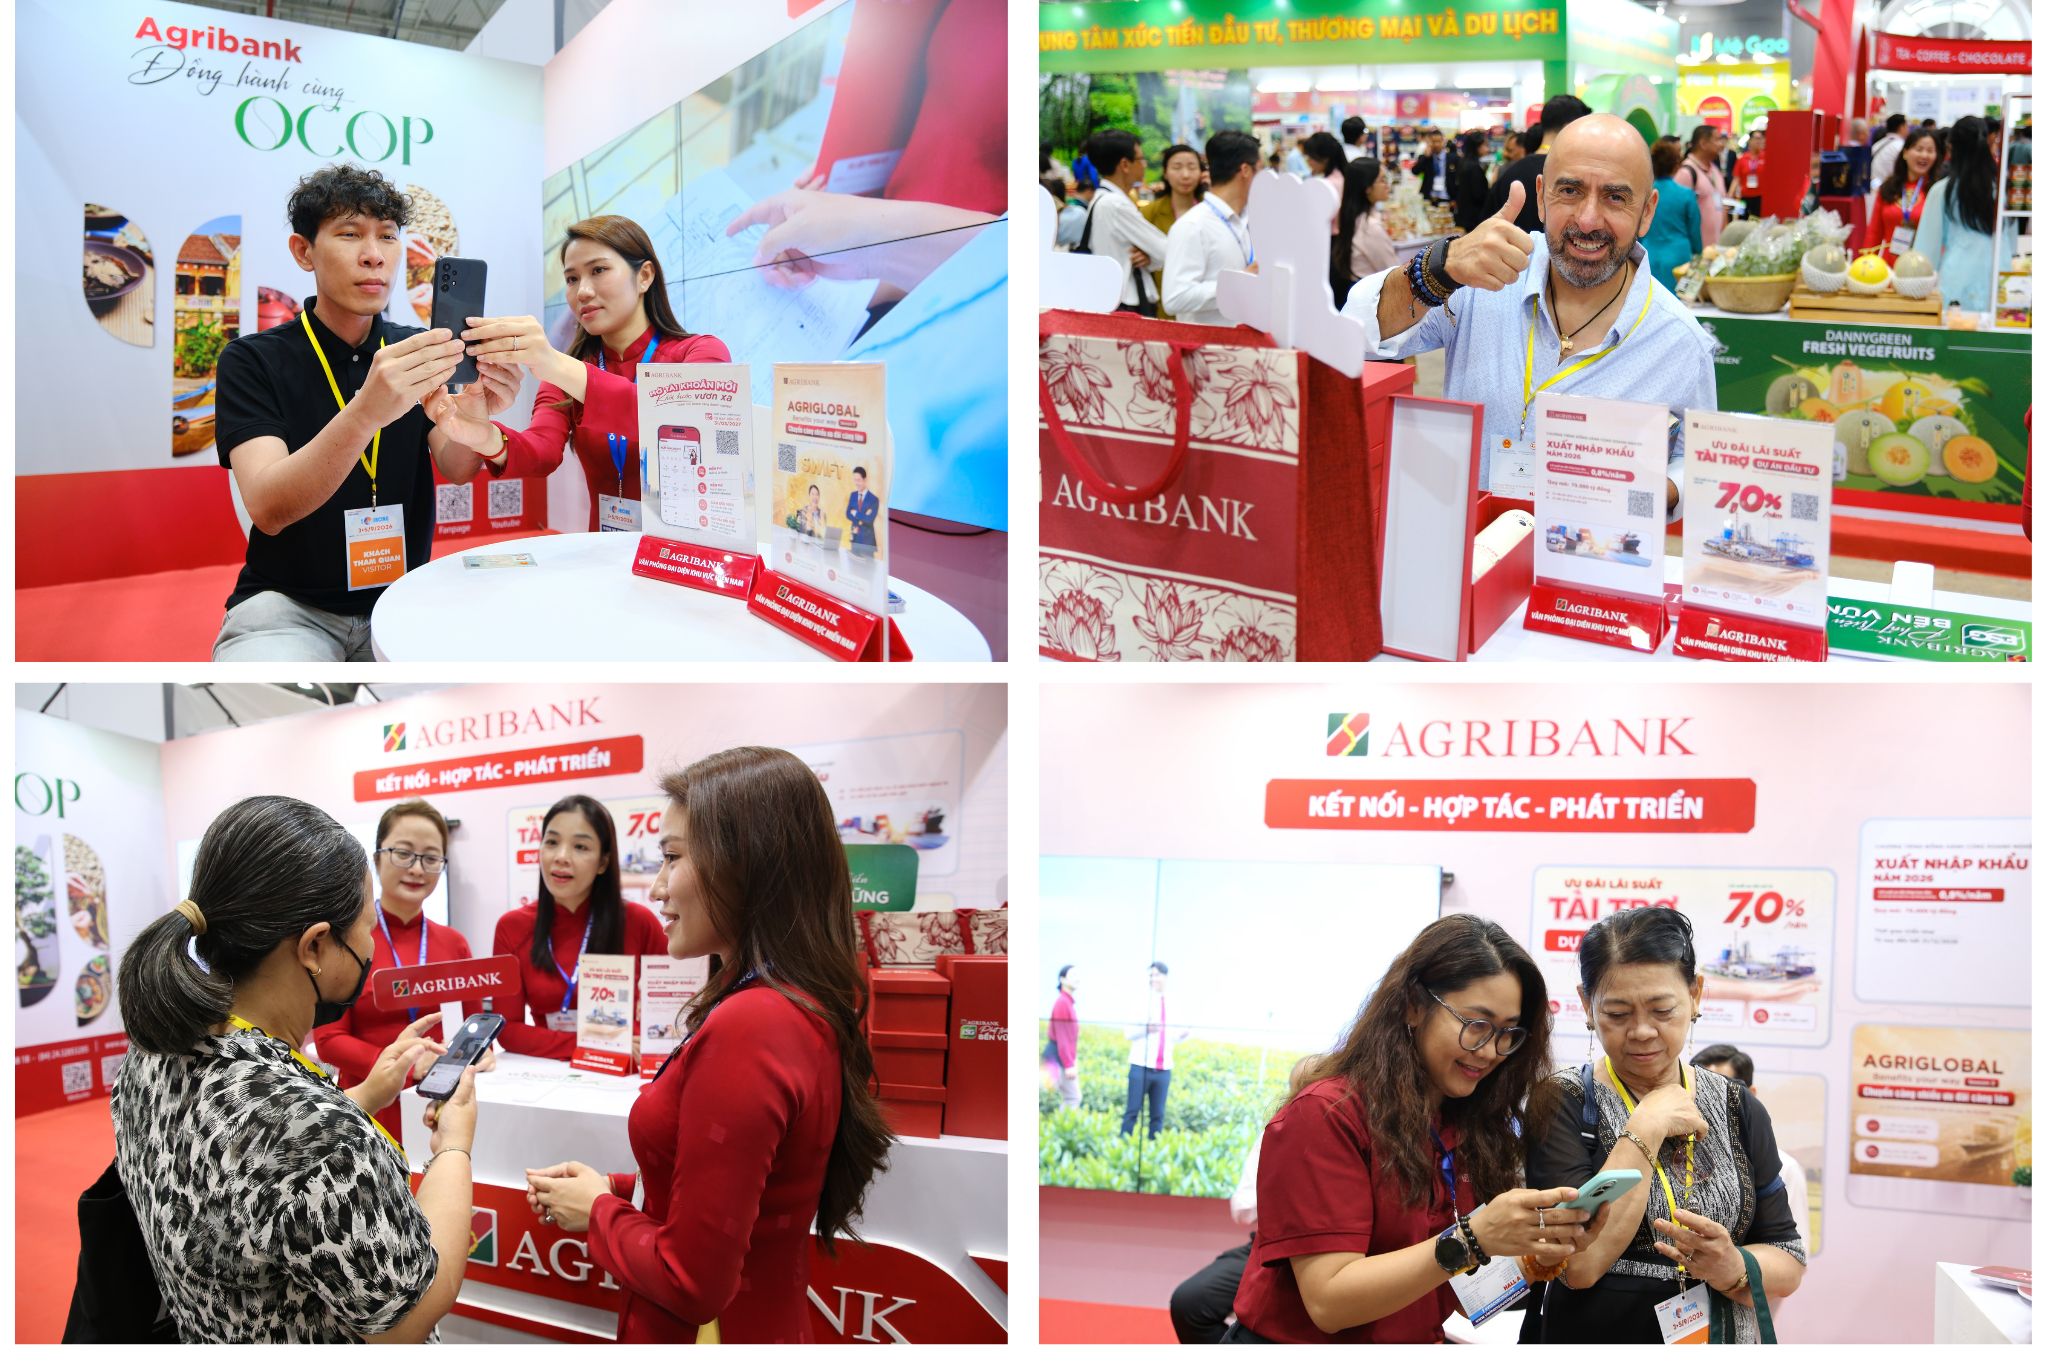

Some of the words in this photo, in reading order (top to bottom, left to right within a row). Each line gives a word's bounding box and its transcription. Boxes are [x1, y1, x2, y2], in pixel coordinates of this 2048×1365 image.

[135, 16, 302, 63] Agribank
[1081, 25, 1118, 49] TÂM
[1123, 22, 1162, 48] XÚC
[1165, 16, 1204, 47] TIẾN
[1209, 13, 1249, 46] ĐẦU
[1288, 17, 1375, 42] THƯƠNG
[1379, 14, 1423, 45] MẠI
[1427, 8, 1460, 37] VÀ
[1464, 13, 1497, 36] DU
[1503, 9, 1559, 41] LỊCH
[1958, 51, 2025, 65] CHOCOLATE
[128, 45, 232, 96] Đồng
[236, 61, 291, 93] hành
[302, 77, 355, 112] cùng
[234, 95, 434, 166] OCOP
[1825, 329, 1912, 346] DANNYGREEN
[1803, 340, 1847, 356] FRESH
[1848, 344, 1935, 361] VEGEFRUITS
[787, 401, 860, 418] AGRIGLOBAL
[1547, 439, 1573, 450] XUẤT
[1575, 444, 1603, 454] NHẬP
[1695, 448, 1717, 463] TÀI
[1720, 454, 1749, 469] TRỢ
[1715, 481, 1782, 514] 7,0%
[438, 524, 471, 535] Fanpage
[490, 519, 521, 529] Youtube
[363, 564, 392, 573] VISITOR
[786, 593, 840, 626] AGRIBANK
[1567, 603, 1628, 623] AGRIBANK
[1891, 612, 1952, 629] BỀN
[1719, 629, 1787, 651] AGRIBANK
[1877, 636, 2000, 659] AGRIBANK
[414, 696, 603, 750] AGRIBANK
[1381, 716, 1697, 758] AGRIBANK
[376, 773, 402, 793] KẾT
[404, 771, 430, 791] NỐI
[439, 766, 472, 788] HỢP
[473, 762, 503, 783] TÁC
[514, 755, 559, 777] PHÁT
[561, 746, 611, 772] TRIỂN
[1308, 790, 1355, 818] KẾT
[1358, 790, 1404, 818] NỐI
[1424, 793, 1478, 824] HỢP
[1482, 791, 1530, 819] TÁC
[1550, 792, 1621, 819] PHÁT
[1623, 789, 1703, 820] TRIỂN
[1875, 853, 1919, 869] XUẤT
[1924, 856, 1973, 873] NHẬP
[1979, 852, 2028, 870] KHẨU
[1565, 879, 1581, 888] ƯU
[1585, 879, 1606, 889] ĐÃI
[1609, 879, 1628, 889] LÃI
[1632, 877, 1662, 889] SUẤT
[1874, 873, 1900, 882] NĂM
[1549, 890, 1599, 920] TÀI
[1723, 891, 1805, 928] 7,0%
[412, 972, 502, 995] AGRIBANK
[1863, 1054, 2004, 1074] AGRIGLOBAL
